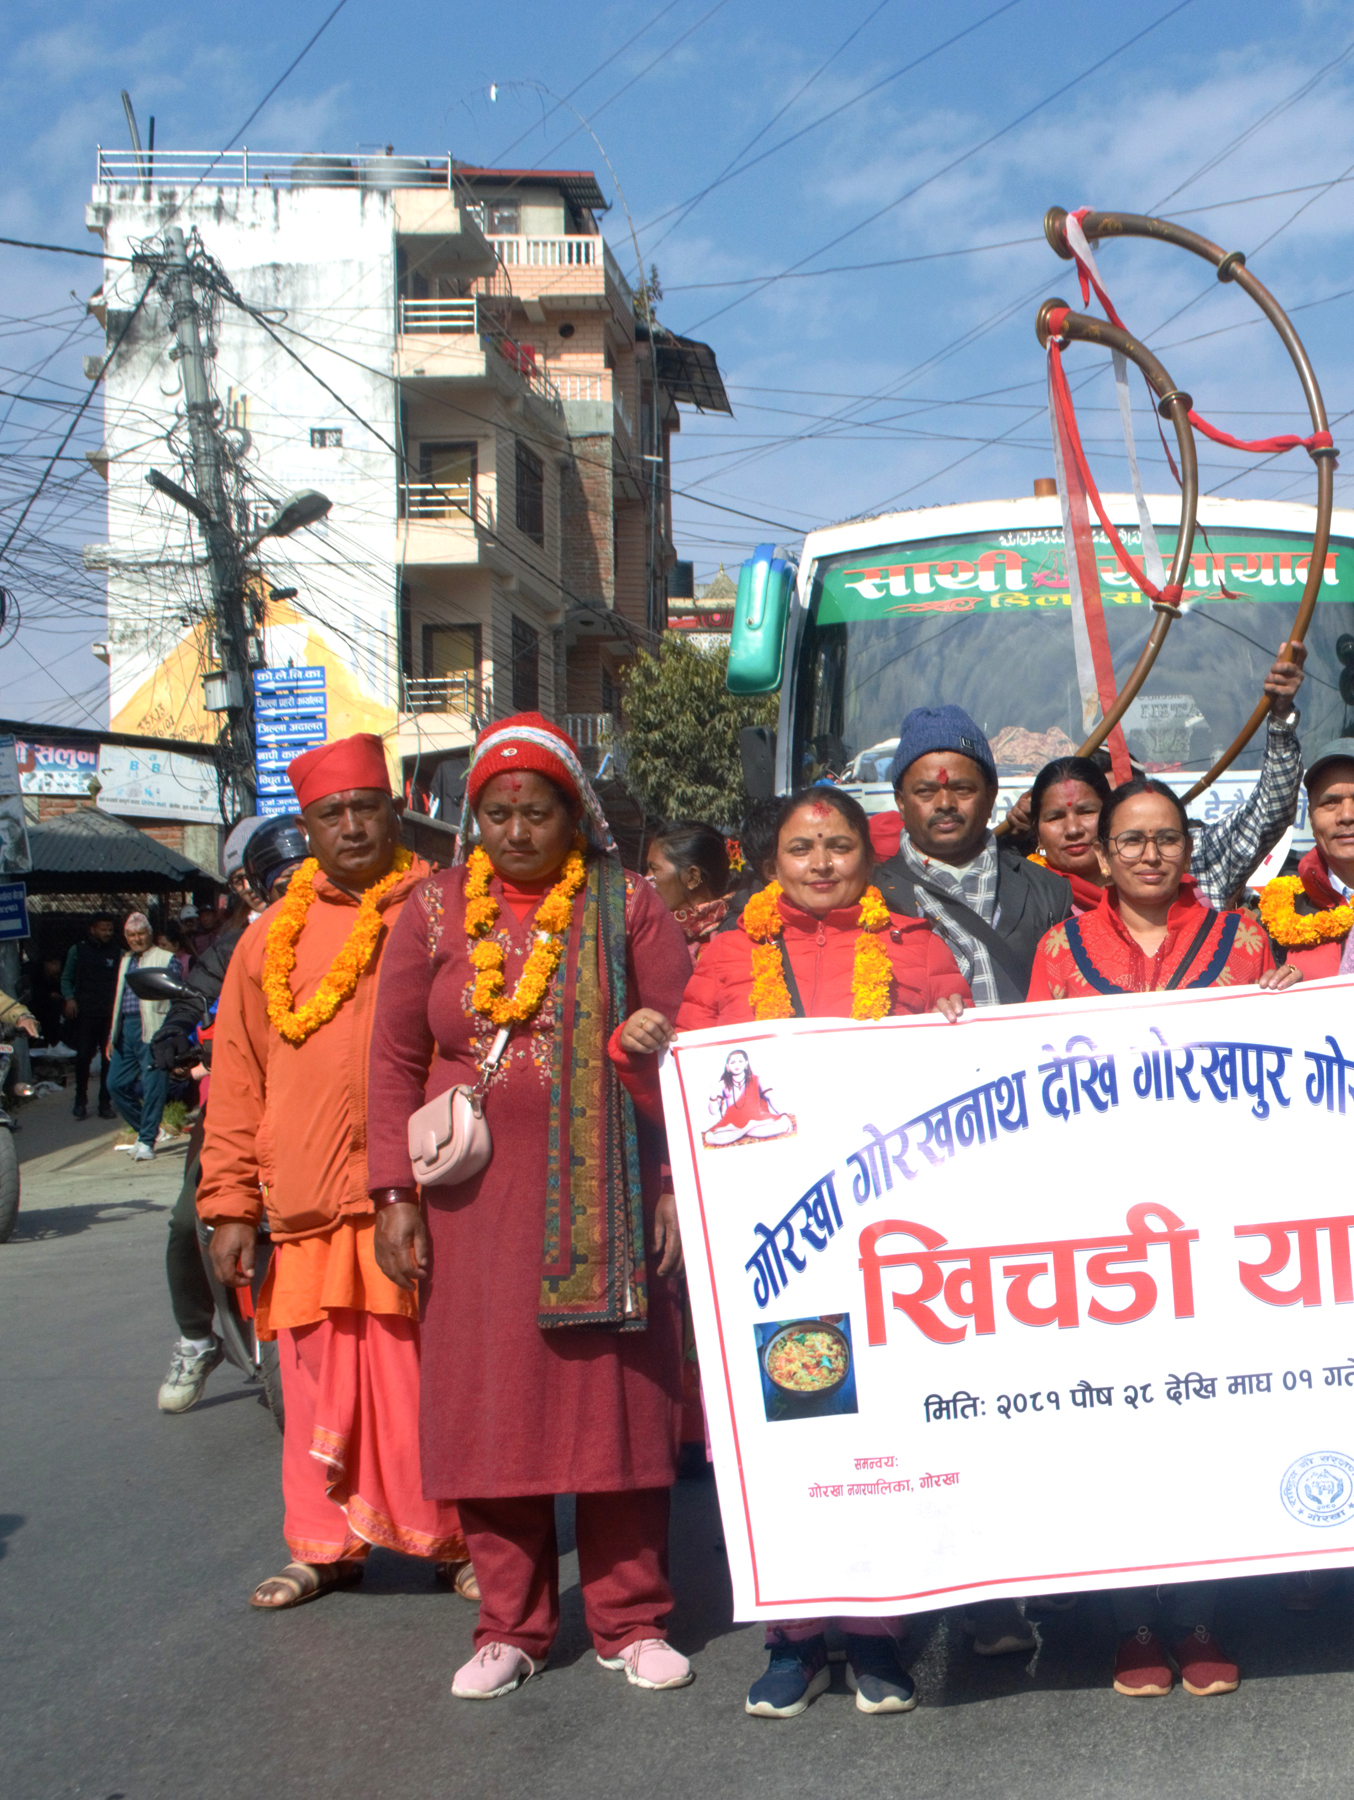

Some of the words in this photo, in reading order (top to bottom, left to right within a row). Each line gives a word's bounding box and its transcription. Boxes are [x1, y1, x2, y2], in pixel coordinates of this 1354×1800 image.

[843, 550, 1028, 600] साथी
[257, 723, 287, 734] जिल्ला
[289, 721, 323, 732] अदालत
[257, 749, 279, 760] नापी
[745, 1169, 844, 1309] गोरखा
[846, 1067, 1029, 1206] गोरखनाथ
[1037, 1035, 1119, 1123] देखि
[1130, 1026, 1293, 1120] गोरखपुर
[858, 1202, 1200, 1347] खिचडी
[996, 1389, 1061, 1420] २०८१
[1070, 1379, 1114, 1410] पौष
[1123, 1382, 1155, 1410] २८
[1165, 1372, 1218, 1407] देखि
[1226, 1372, 1273, 1396] माघ
[1281, 1368, 1314, 1393] ०१
[808, 1482, 844, 1498] गोरखा
[847, 1478, 914, 1496] नगरपालिका,
[919, 1472, 960, 1490] गोरखा
